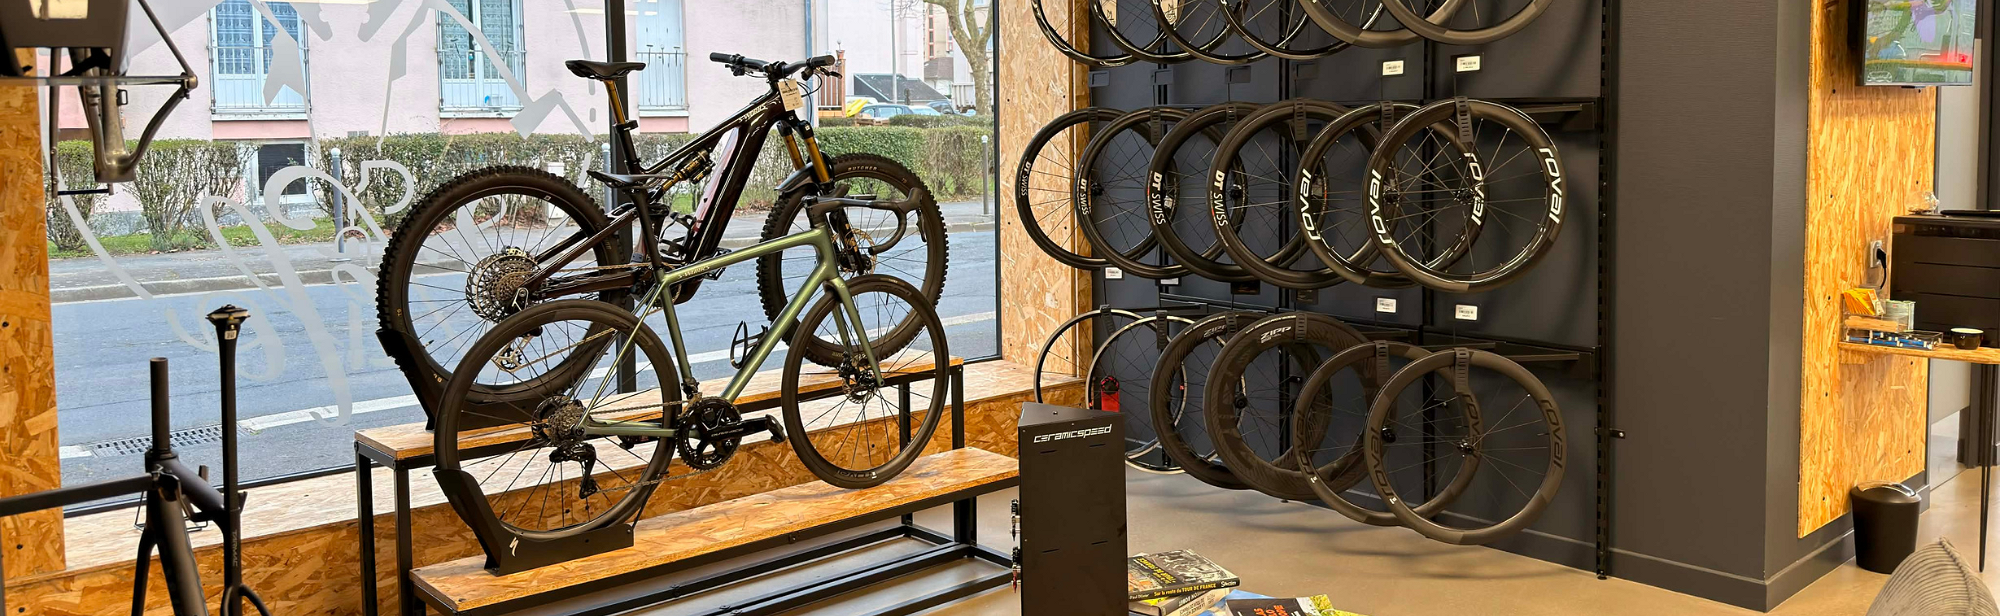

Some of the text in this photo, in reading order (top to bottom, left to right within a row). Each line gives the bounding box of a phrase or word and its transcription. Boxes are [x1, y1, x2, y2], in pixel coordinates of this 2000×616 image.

[1021, 161, 1031, 196] DT SWISS
[1080, 178, 1089, 215] DT SWISS
[1151, 171, 1163, 191] DT
[1213, 169, 1225, 191] DT
[1300, 168, 1321, 240] roval
[1463, 152, 1484, 226] roval
[1539, 148, 1562, 224] roval
[1151, 193, 1166, 225] SWISS
[1213, 192, 1228, 227] SWISS
[1369, 169, 1393, 244] roval
[1033, 423, 1113, 443] ceramicspeed
[1297, 410, 1315, 475] roval
[1541, 400, 1563, 468] roval
[1371, 427, 1394, 497] roval
